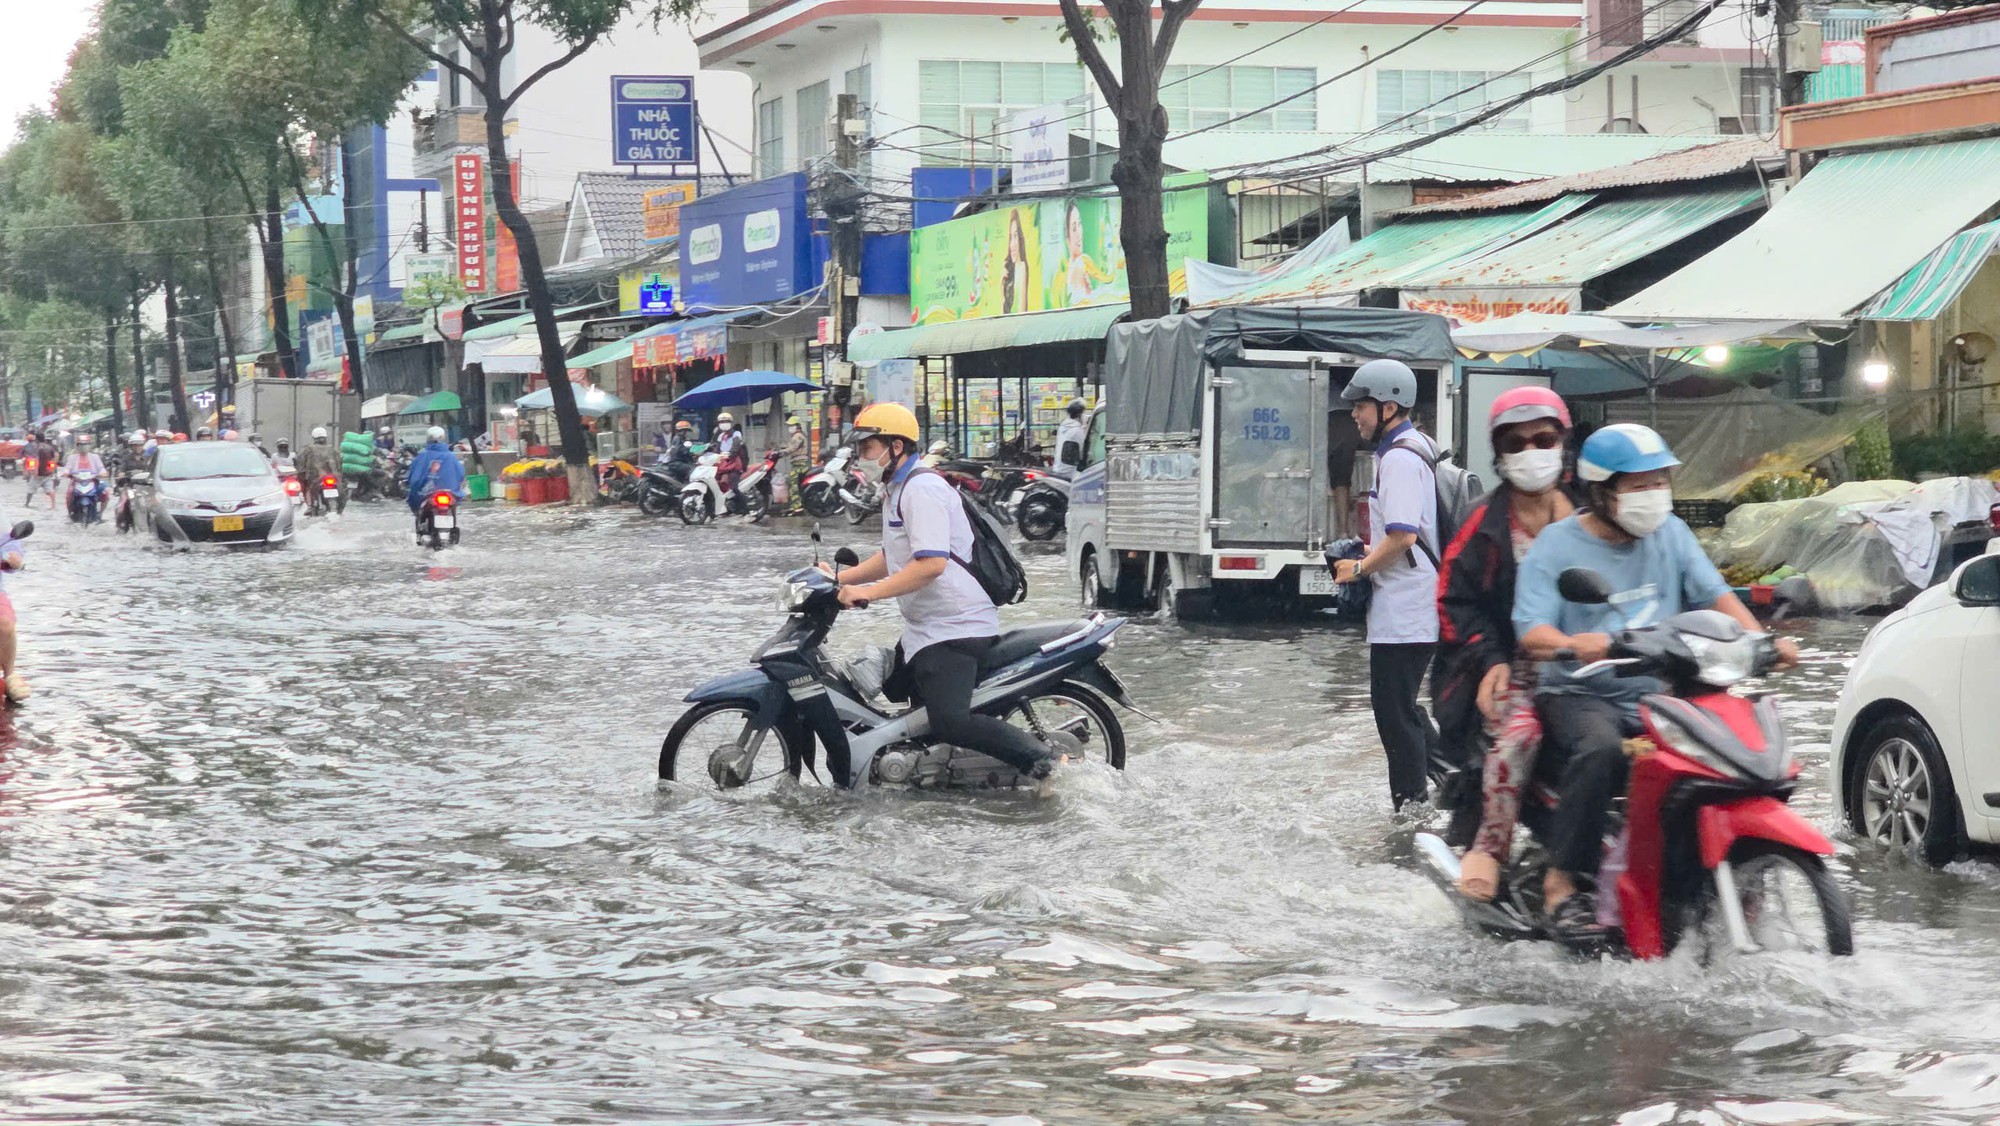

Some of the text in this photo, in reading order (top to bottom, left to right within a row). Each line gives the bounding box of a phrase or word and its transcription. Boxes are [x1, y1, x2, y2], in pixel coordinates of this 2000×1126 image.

[638, 106, 671, 122] NHÀ
[629, 122, 680, 141] THUỐC
[628, 141, 683, 159] GIÁ TỐT
[1253, 408, 1279, 423] 66C
[1244, 425, 1291, 440] 150.28
[787, 674, 813, 688] YAMAHA
